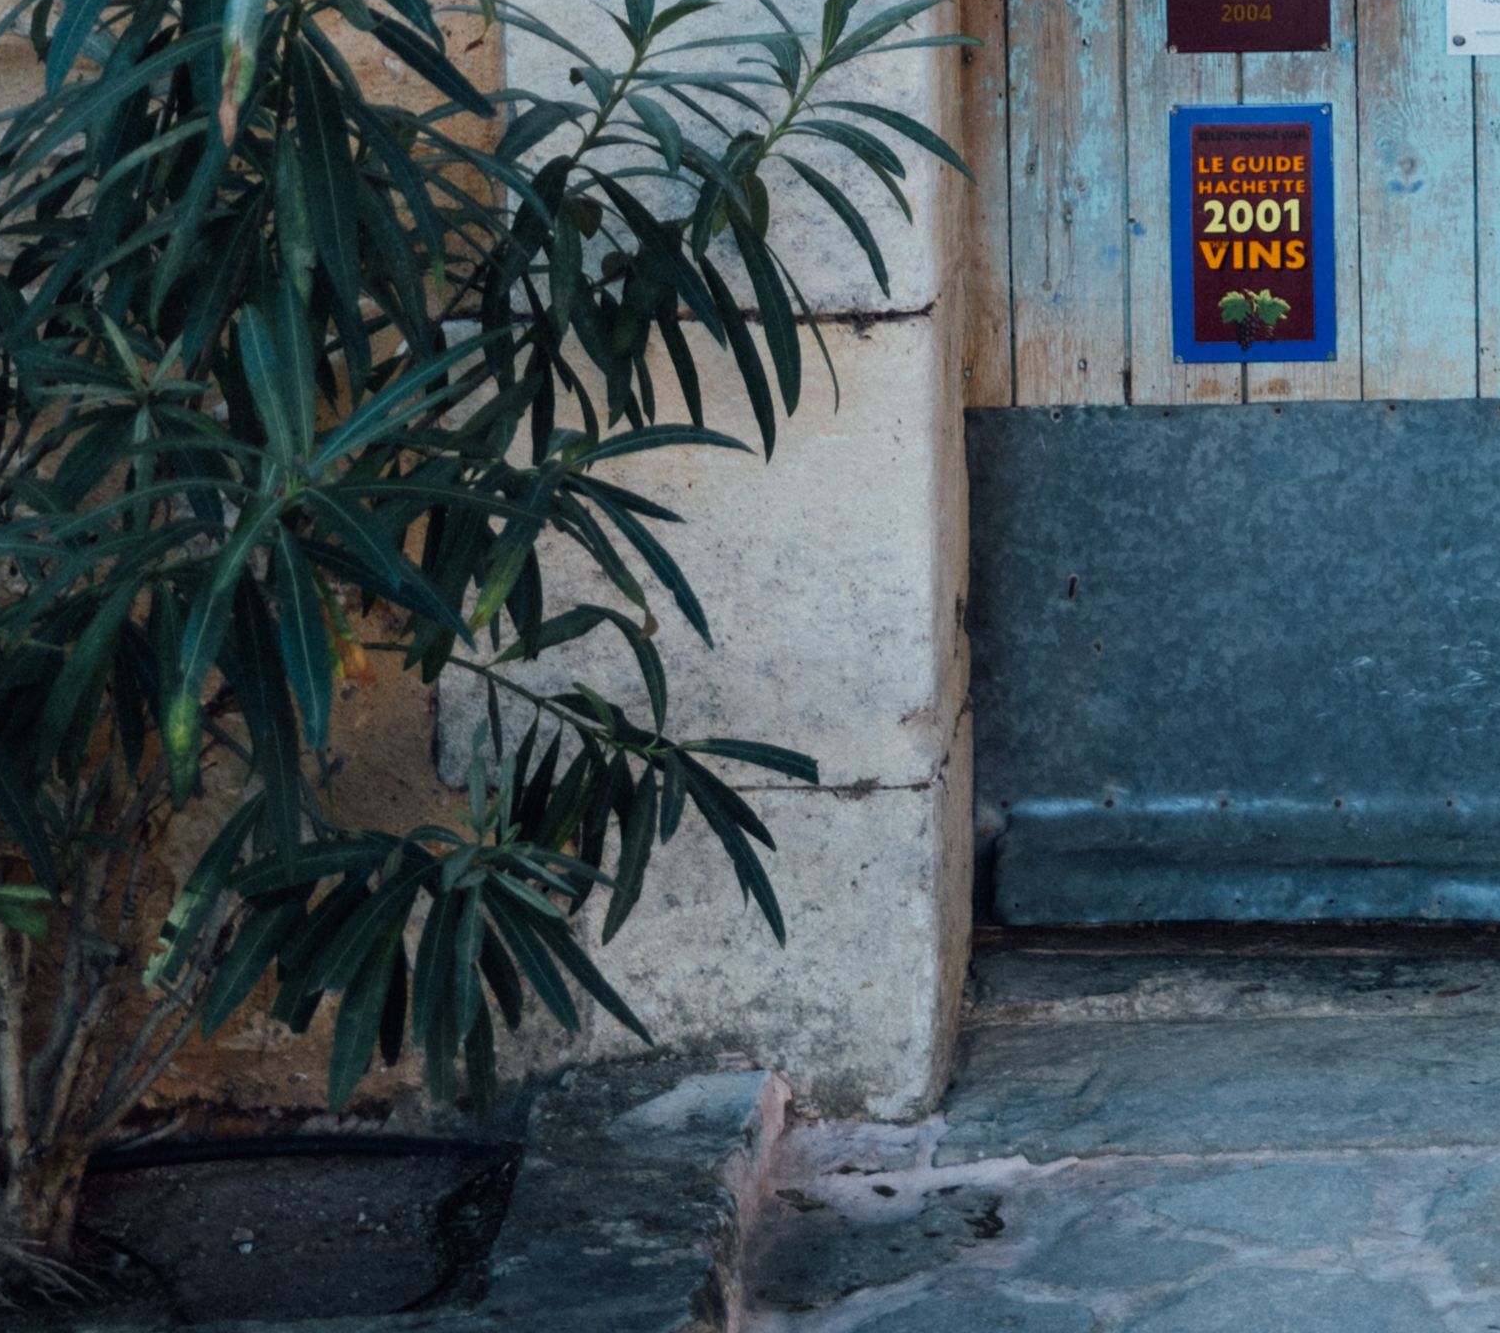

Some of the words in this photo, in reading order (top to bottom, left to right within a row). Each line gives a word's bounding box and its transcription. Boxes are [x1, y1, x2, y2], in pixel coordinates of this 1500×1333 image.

[1221, 4, 1272, 22] 2004
[1199, 157, 1224, 173] LE
[1232, 156, 1305, 173] GUIDE
[1200, 180, 1305, 194] HACHETTE
[1204, 199, 1300, 233] 2001
[1200, 240, 1306, 269] VINS
